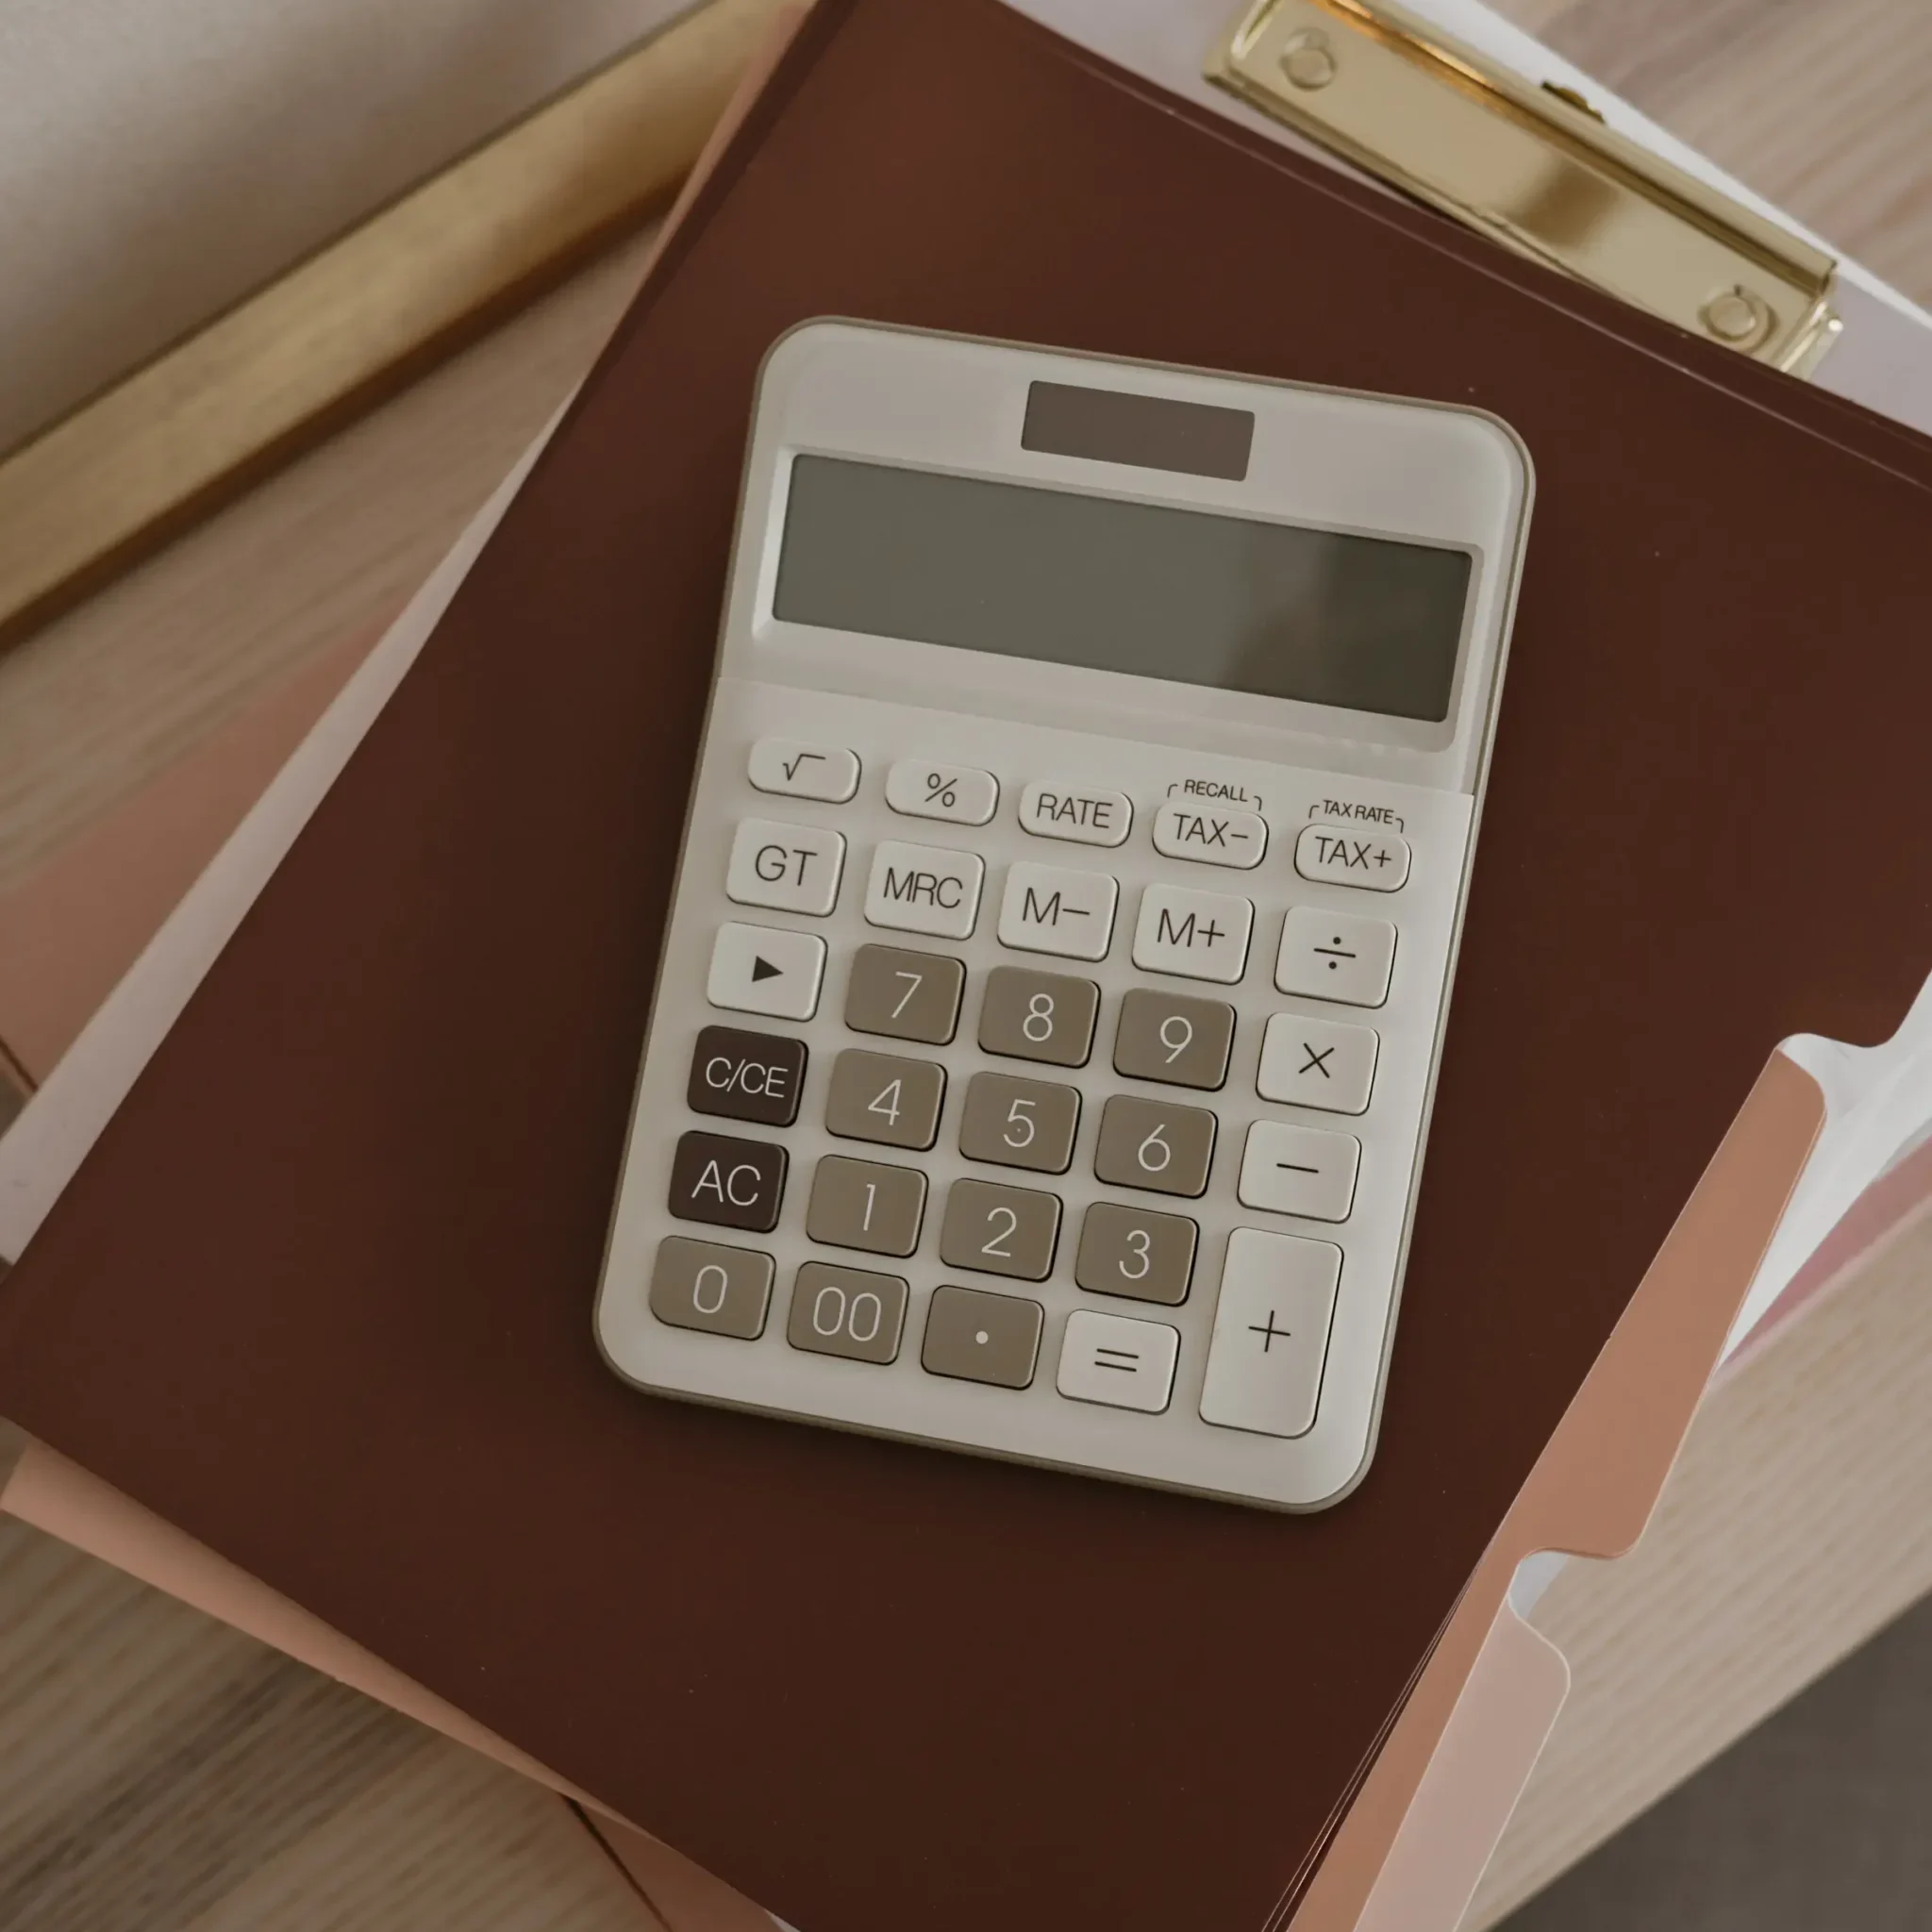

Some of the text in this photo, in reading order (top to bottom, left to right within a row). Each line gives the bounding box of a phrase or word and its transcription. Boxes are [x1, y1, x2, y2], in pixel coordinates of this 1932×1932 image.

[1037, 793, 1112, 828] RATE
[1185, 779, 1247, 802] RECALL
[1324, 800, 1393, 824] TAX RATE
[756, 845, 817, 886] GT
[1315, 837, 1391, 869] TAX+
[884, 868, 962, 908] MRC
[1158, 908, 1224, 947] M+
[891, 972, 922, 1018] 7
[1024, 993, 1054, 1041] 8
[1160, 1016, 1191, 1062] 9
[707, 1058, 788, 1097] C/CE
[868, 1080, 901, 1125] 4
[1004, 1099, 1035, 1147] 5
[1139, 1124, 1170, 1171] 6
[691, 1160, 760, 1206] AC
[864, 1184, 875, 1230] 1
[982, 1208, 1016, 1257] 2
[1120, 1230, 1150, 1278] 3
[693, 1265, 727, 1313] 0
[813, 1287, 881, 1341] 00
